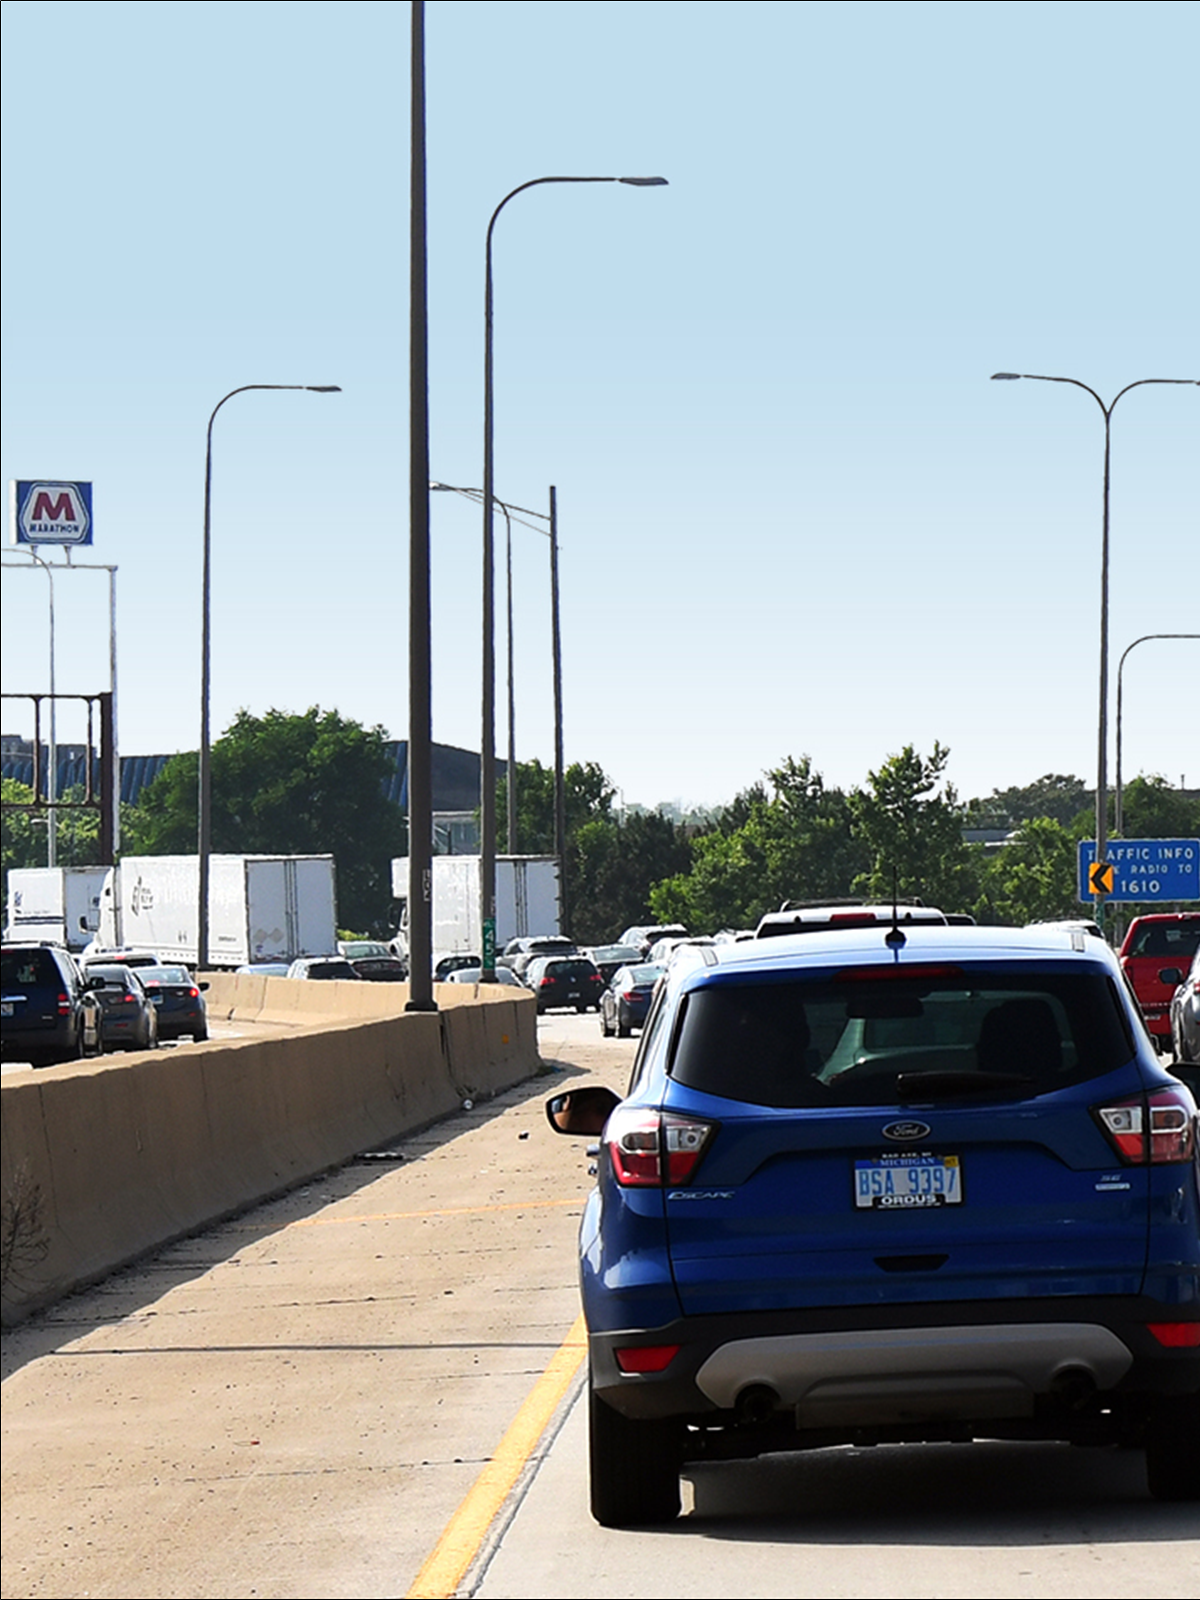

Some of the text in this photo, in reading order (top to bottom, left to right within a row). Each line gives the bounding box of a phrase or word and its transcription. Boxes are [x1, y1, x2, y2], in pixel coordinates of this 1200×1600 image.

[32, 492, 76, 521] M
[29, 523, 79, 533] MARATHON
[1087, 847, 1194, 860] TAFFIC INFO
[1130, 864, 1168, 874] RADIO
[1178, 863, 1192, 874] TO
[1121, 880, 1161, 893] 1610
[892, 1124, 919, 1136] Ford
[880, 1157, 935, 1166] MICHIGAN
[859, 1167, 957, 1196] BSA 9397
